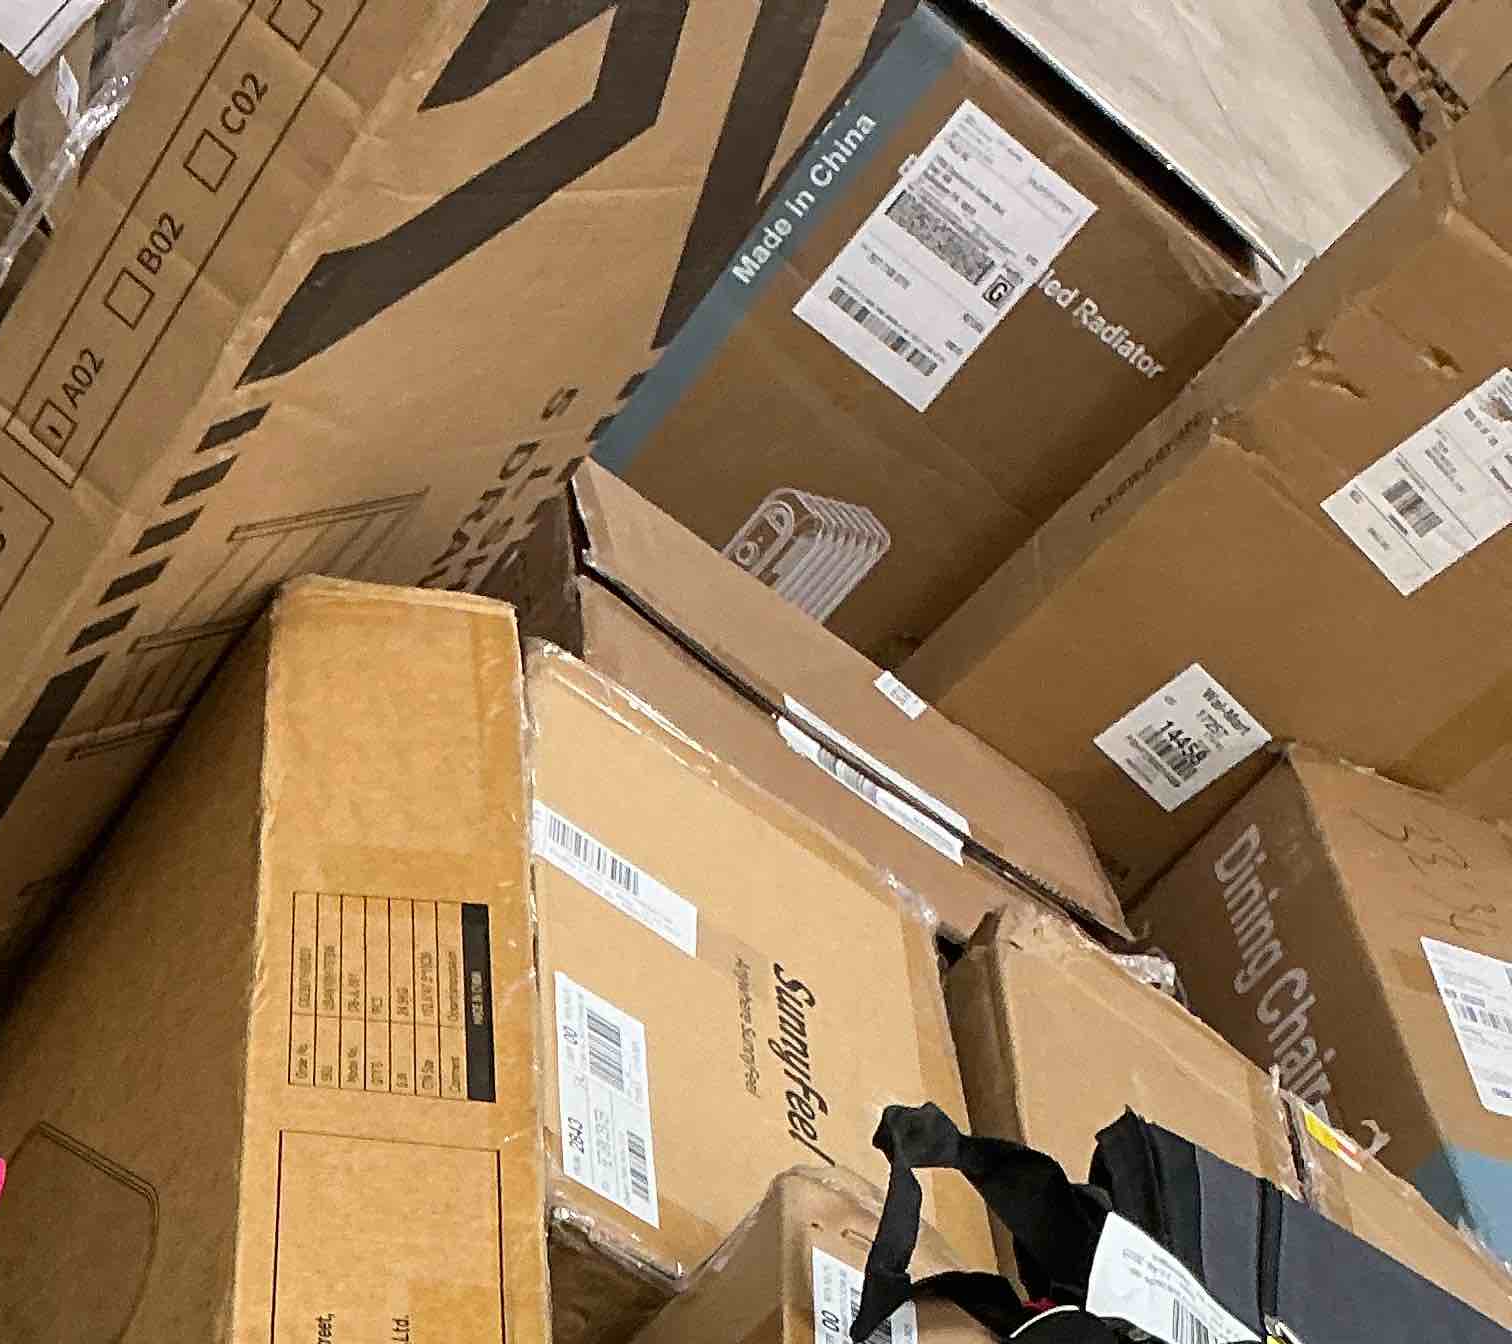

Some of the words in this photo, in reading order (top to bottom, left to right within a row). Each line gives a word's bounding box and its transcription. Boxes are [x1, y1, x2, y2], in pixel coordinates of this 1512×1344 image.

[220, 72, 268, 136] C02
[731, 215, 793, 286] Made
[809, 110, 878, 188] China
[136, 213, 185, 277] B02
[1072, 297, 1167, 380] Radiator
[61, 347, 106, 411] A02
[1214, 823, 1283, 995] Dining
[821, 1309, 840, 1333] 00
